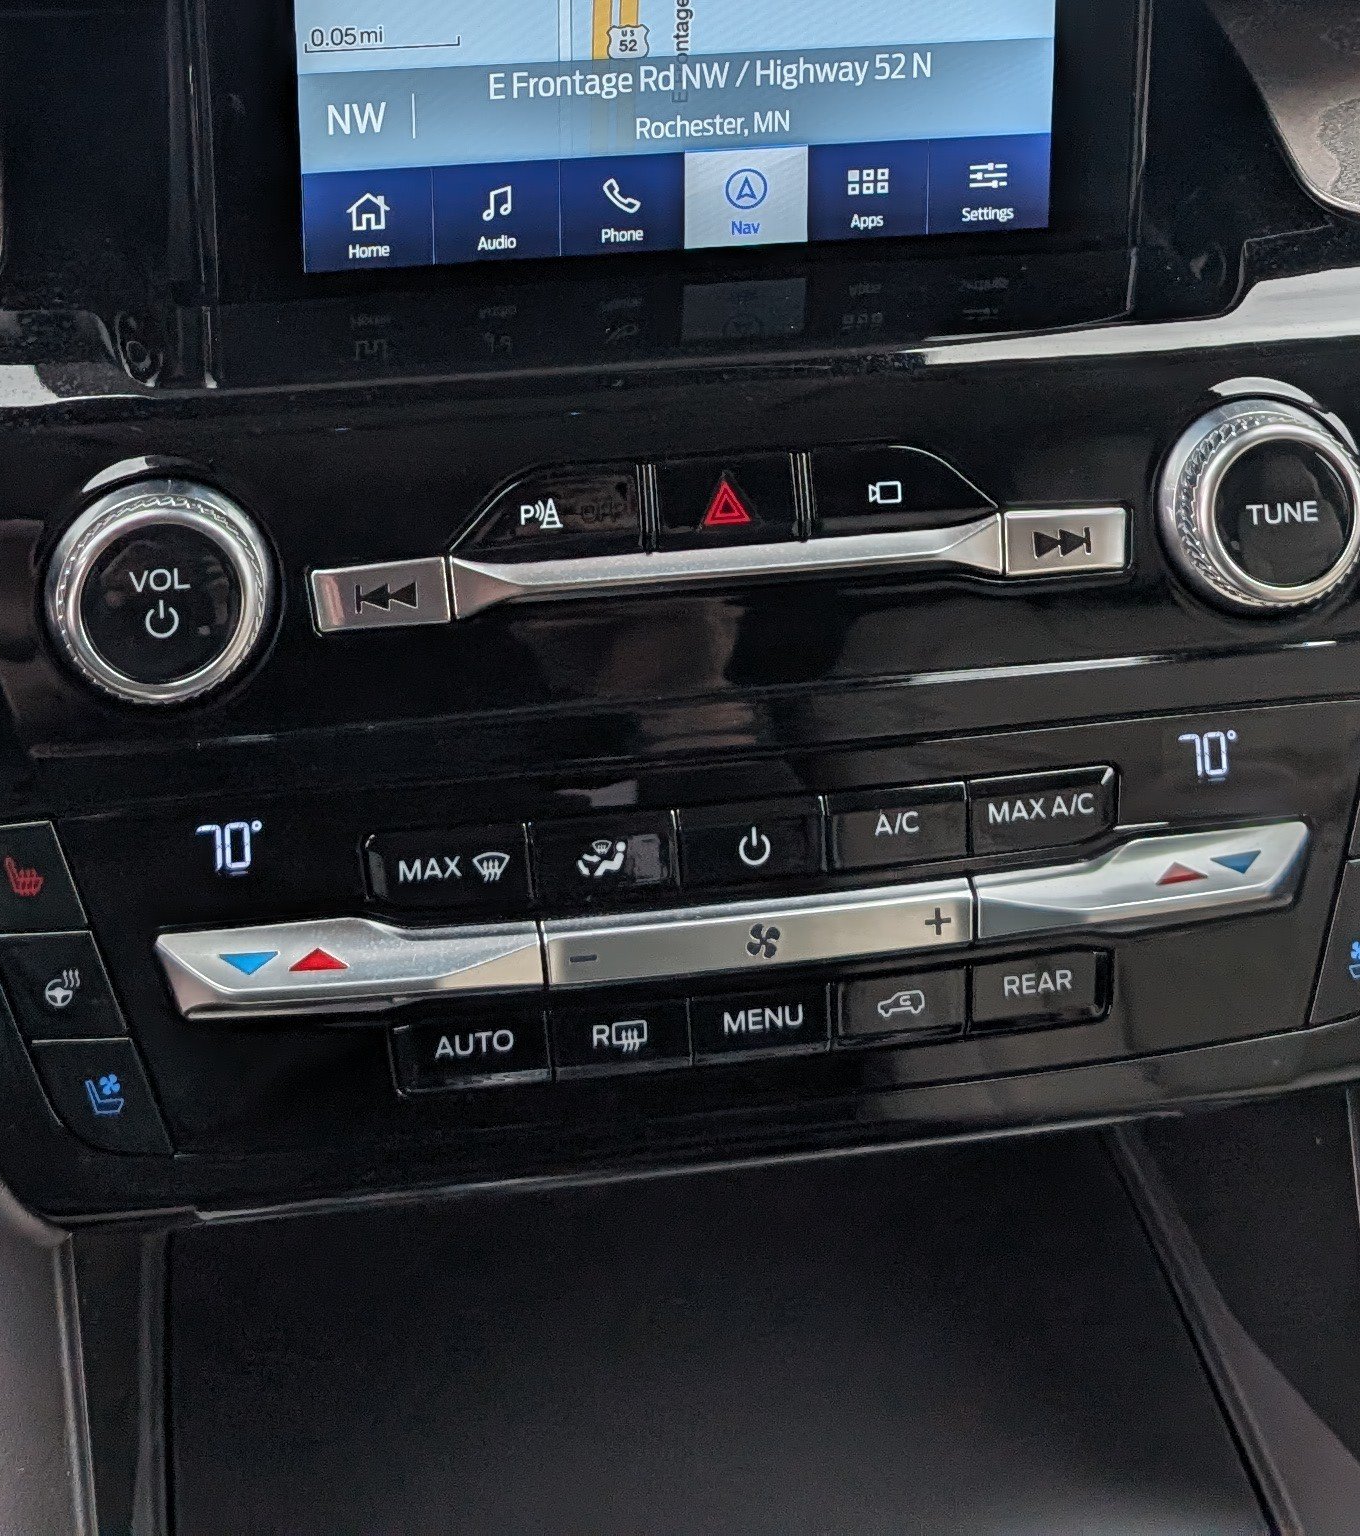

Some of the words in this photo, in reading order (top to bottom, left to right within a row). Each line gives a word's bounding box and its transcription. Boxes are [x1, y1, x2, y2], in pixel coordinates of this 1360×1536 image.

[310, 27, 357, 48] 0.05
[359, 26, 384, 45] mi
[618, 39, 638, 53] 52
[488, 72, 507, 101] E
[512, 65, 633, 99] Frontage
[640, 63, 675, 93] Rd
[681, 61, 730, 89] NW
[735, 61, 749, 88] /
[756, 55, 869, 90] Highway
[874, 53, 906, 81] 52
[911, 51, 933, 79] N
[326, 101, 387, 136] NW
[635, 113, 749, 140] Rochester,
[753, 109, 791, 133] MN
[731, 219, 761, 236] Nav
[850, 213, 884, 230] Apps
[961, 205, 1015, 224] Settings
[477, 235, 517, 252] Audio
[601, 227, 644, 244] Phone
[348, 243, 391, 259] Home
[1245, 498, 1319, 527] TUNE
[128, 568, 191, 593] VOL
[1177, 729, 1239, 780] 70°
[987, 798, 1045, 824] MAX
[1046, 792, 1096, 819] A/C
[874, 810, 920, 838] A/C
[194, 819, 264, 872] 70°
[397, 855, 463, 882] MAX
[1003, 968, 1073, 998] REAR
[722, 1004, 805, 1034] MENU
[434, 1028, 516, 1059] AUTO
[591, 1023, 610, 1047] R
